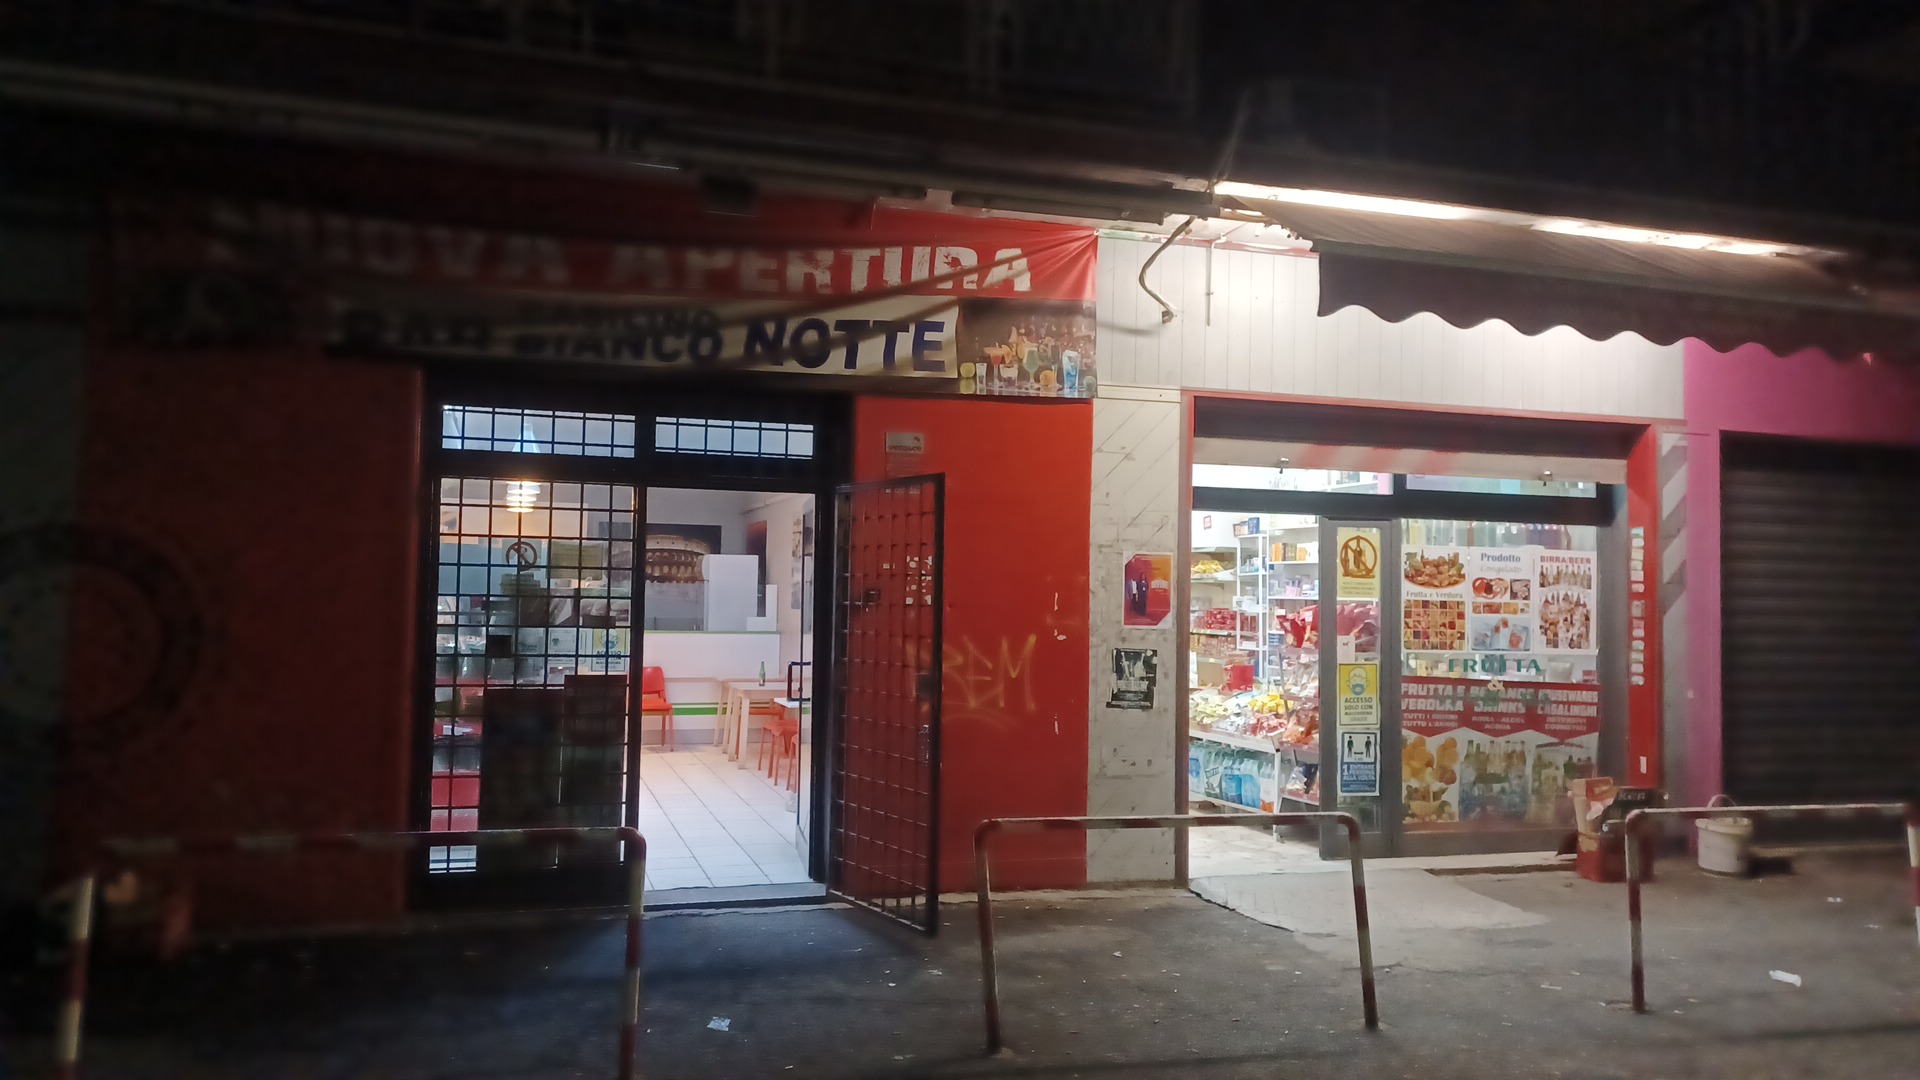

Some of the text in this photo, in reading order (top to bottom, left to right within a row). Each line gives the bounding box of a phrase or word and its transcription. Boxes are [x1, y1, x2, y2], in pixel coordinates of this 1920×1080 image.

[604, 245, 1032, 294] APERTURA
[744, 316, 947, 373] NOTTE
[1480, 552, 1522, 564] Prodotto
[1406, 590, 1428, 599] Frutta
[1448, 658, 1542, 673] FRUTTA
[1401, 683, 1453, 696] FRUTTA
